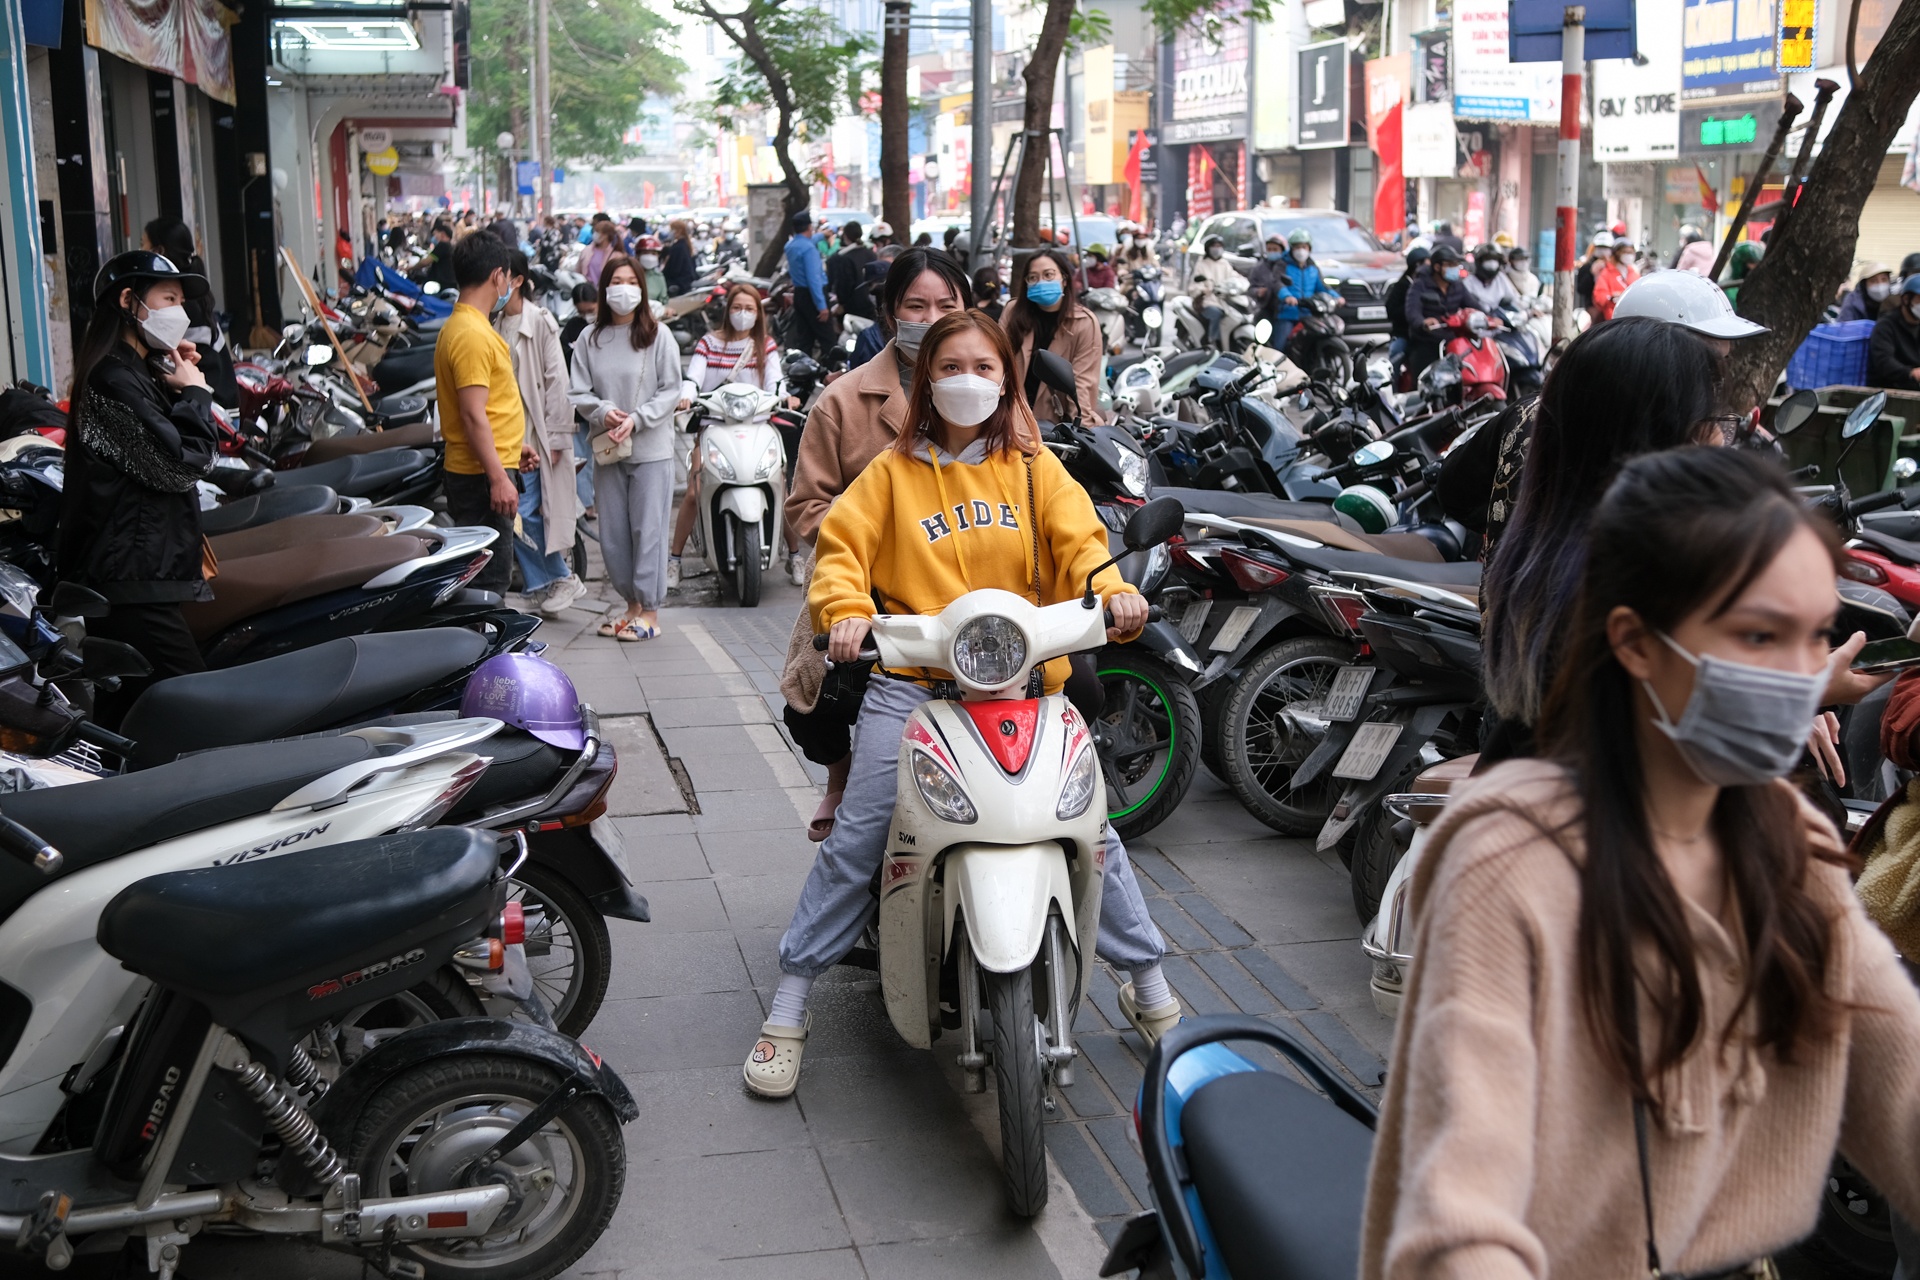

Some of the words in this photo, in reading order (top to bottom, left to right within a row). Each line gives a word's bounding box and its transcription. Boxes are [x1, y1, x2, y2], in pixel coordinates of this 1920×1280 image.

[1634, 93, 1676, 115] STORE
[919, 499, 1020, 544] HIDE
[328, 593, 398, 621] VISION
[493, 675, 517, 686] liebe
[1336, 671, 1367, 693] 88-F1
[484, 692, 506, 702] LOVE
[1337, 751, 1382, 776] 375.00
[212, 820, 333, 867] VISION
[898, 832, 916, 846] SYM
[342, 948, 426, 988] DIBAO
[141, 1066, 181, 1140] DIBAO
